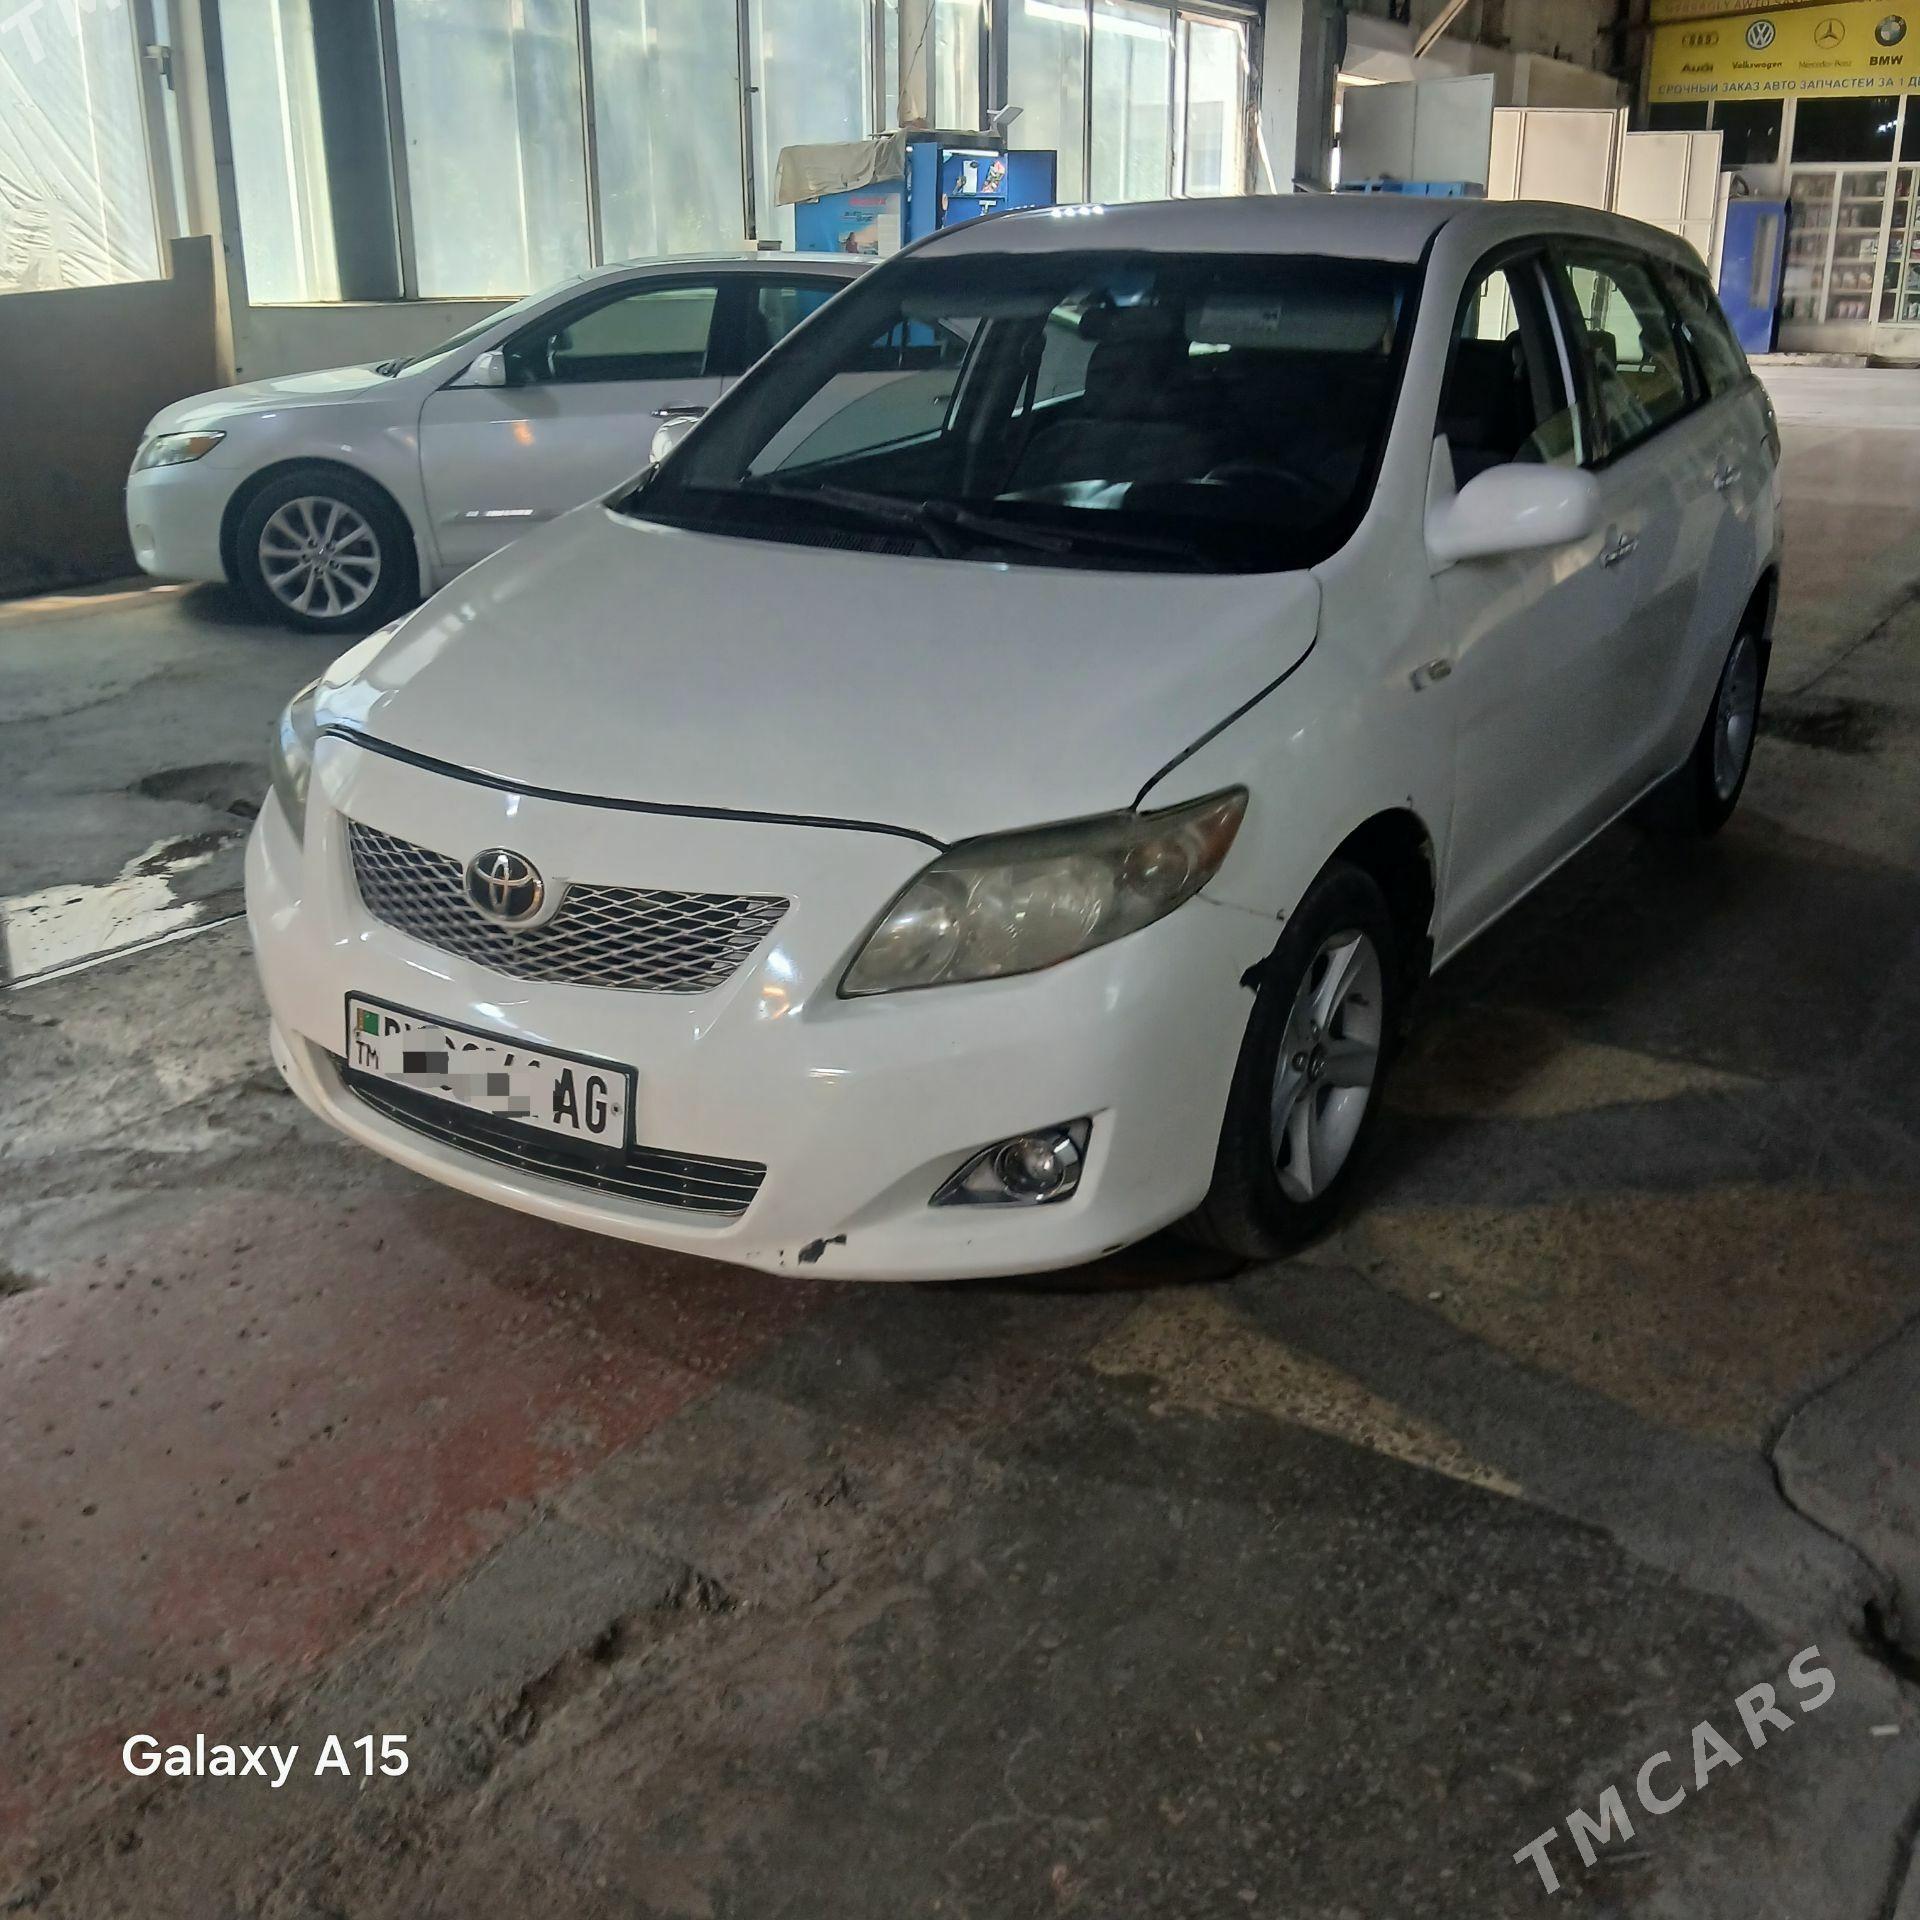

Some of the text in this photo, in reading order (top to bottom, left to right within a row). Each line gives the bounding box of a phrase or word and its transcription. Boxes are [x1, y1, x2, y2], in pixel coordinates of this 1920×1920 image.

[1681, 62, 1714, 73] Audi
[1869, 55, 1904, 66] BMW
[1722, 82, 1760, 92] ЗАКАЗ
[1763, 80, 1796, 91] АВТО
[1878, 77, 1894, 87] ЗА
[356, 1040, 379, 1070] TM
[553, 1068, 608, 1134] AG
